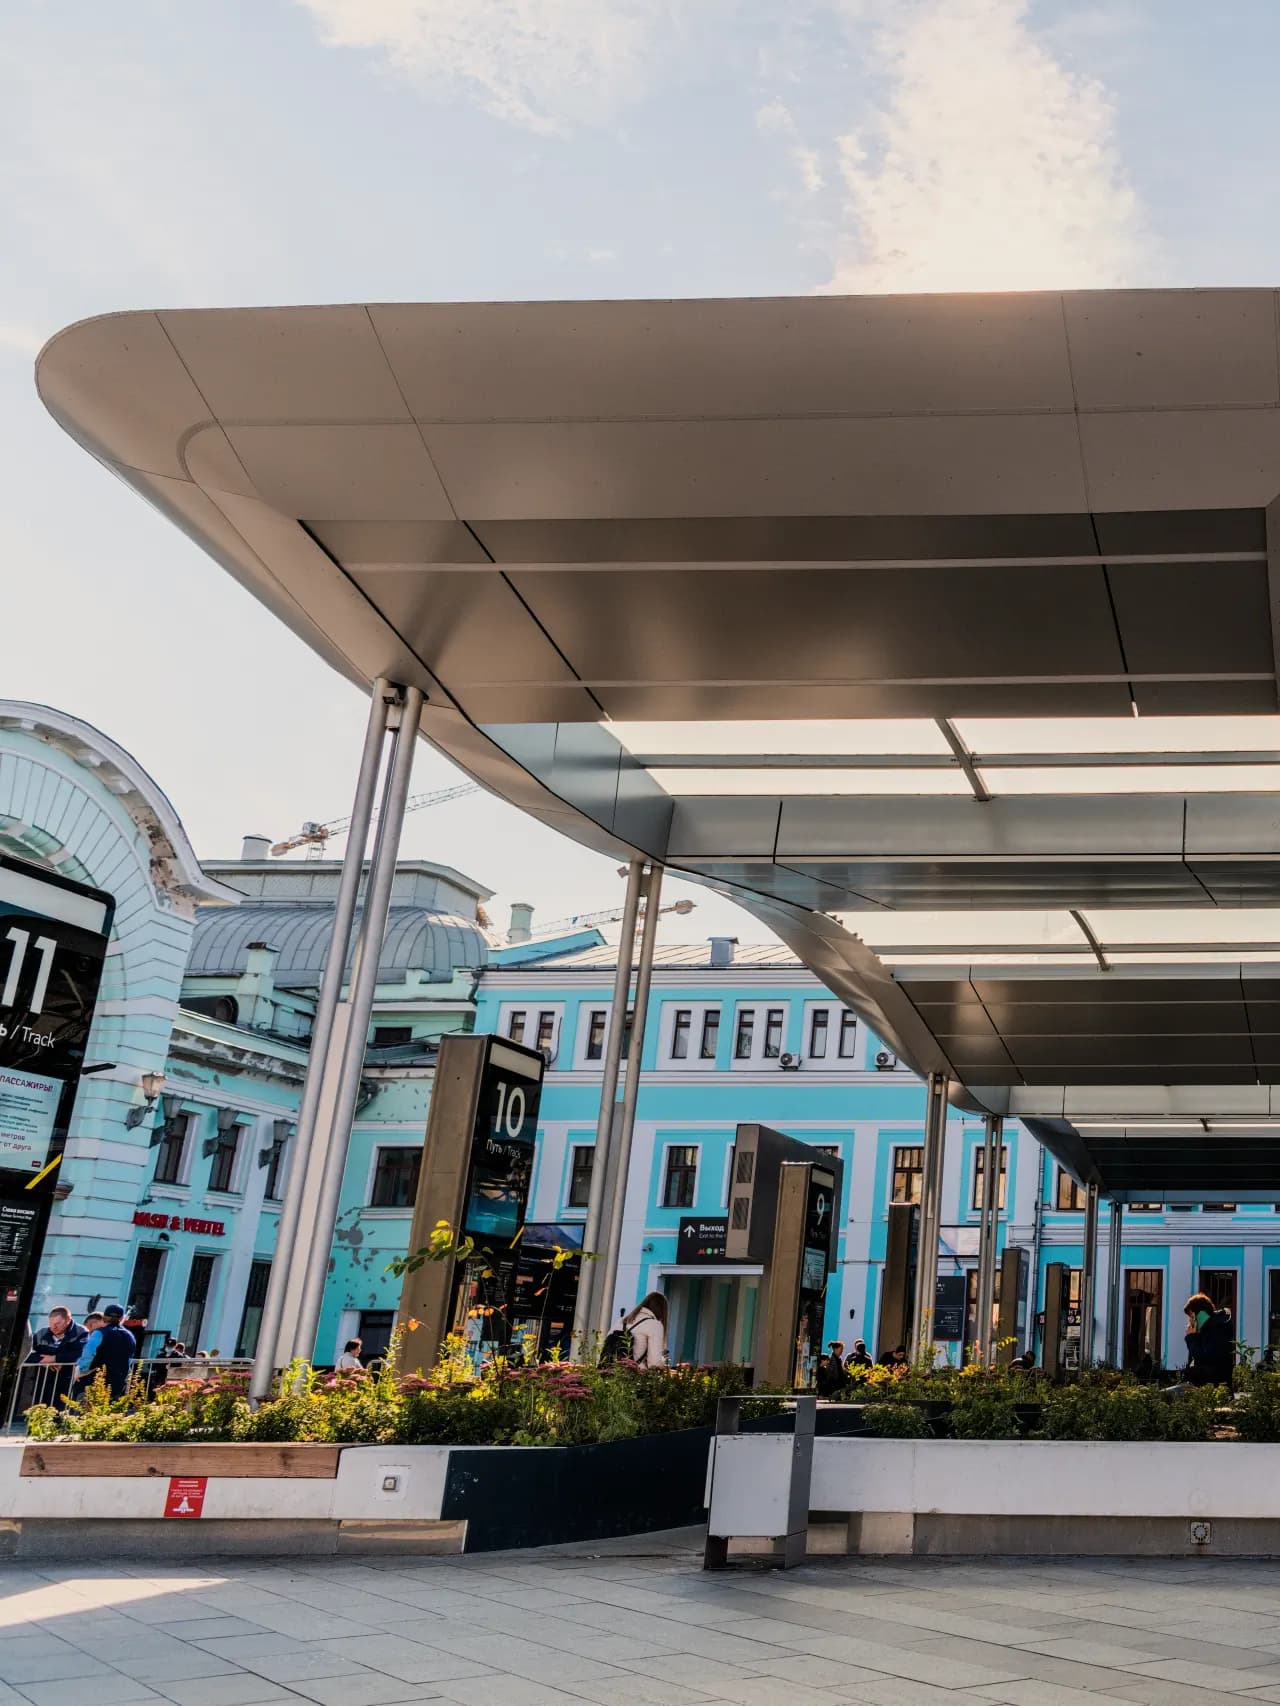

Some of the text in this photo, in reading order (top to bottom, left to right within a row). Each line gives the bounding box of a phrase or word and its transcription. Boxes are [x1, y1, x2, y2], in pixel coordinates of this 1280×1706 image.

[1, 926, 58, 1014] 11
[22, 1026, 56, 1048] Track
[495, 1081, 526, 1138] 10
[816, 1192, 825, 1226] 9
[699, 1223, 725, 1233] Выход
